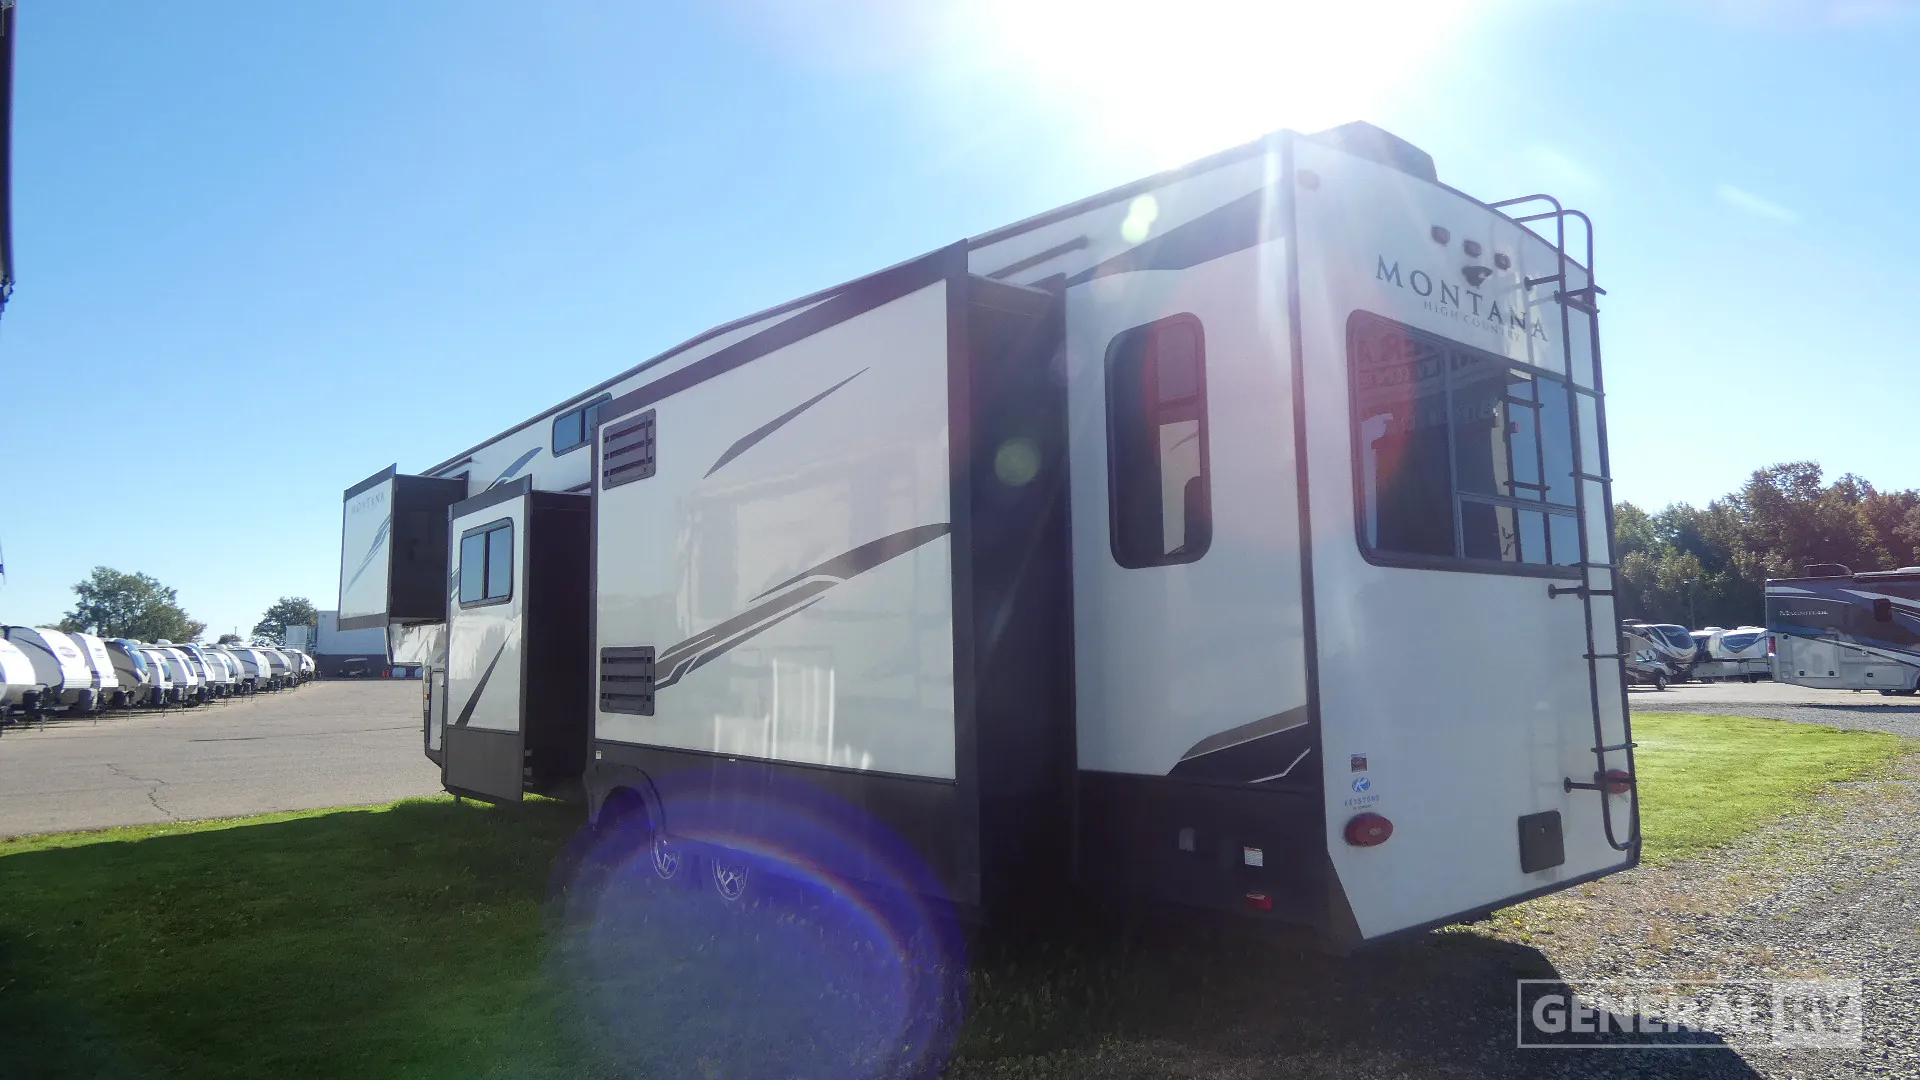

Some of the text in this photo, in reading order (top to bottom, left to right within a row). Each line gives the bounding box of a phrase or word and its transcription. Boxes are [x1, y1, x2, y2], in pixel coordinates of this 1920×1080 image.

[1376, 255, 1548, 341] MONTANA
[1424, 300, 1521, 341] HIGH COUNTRY
